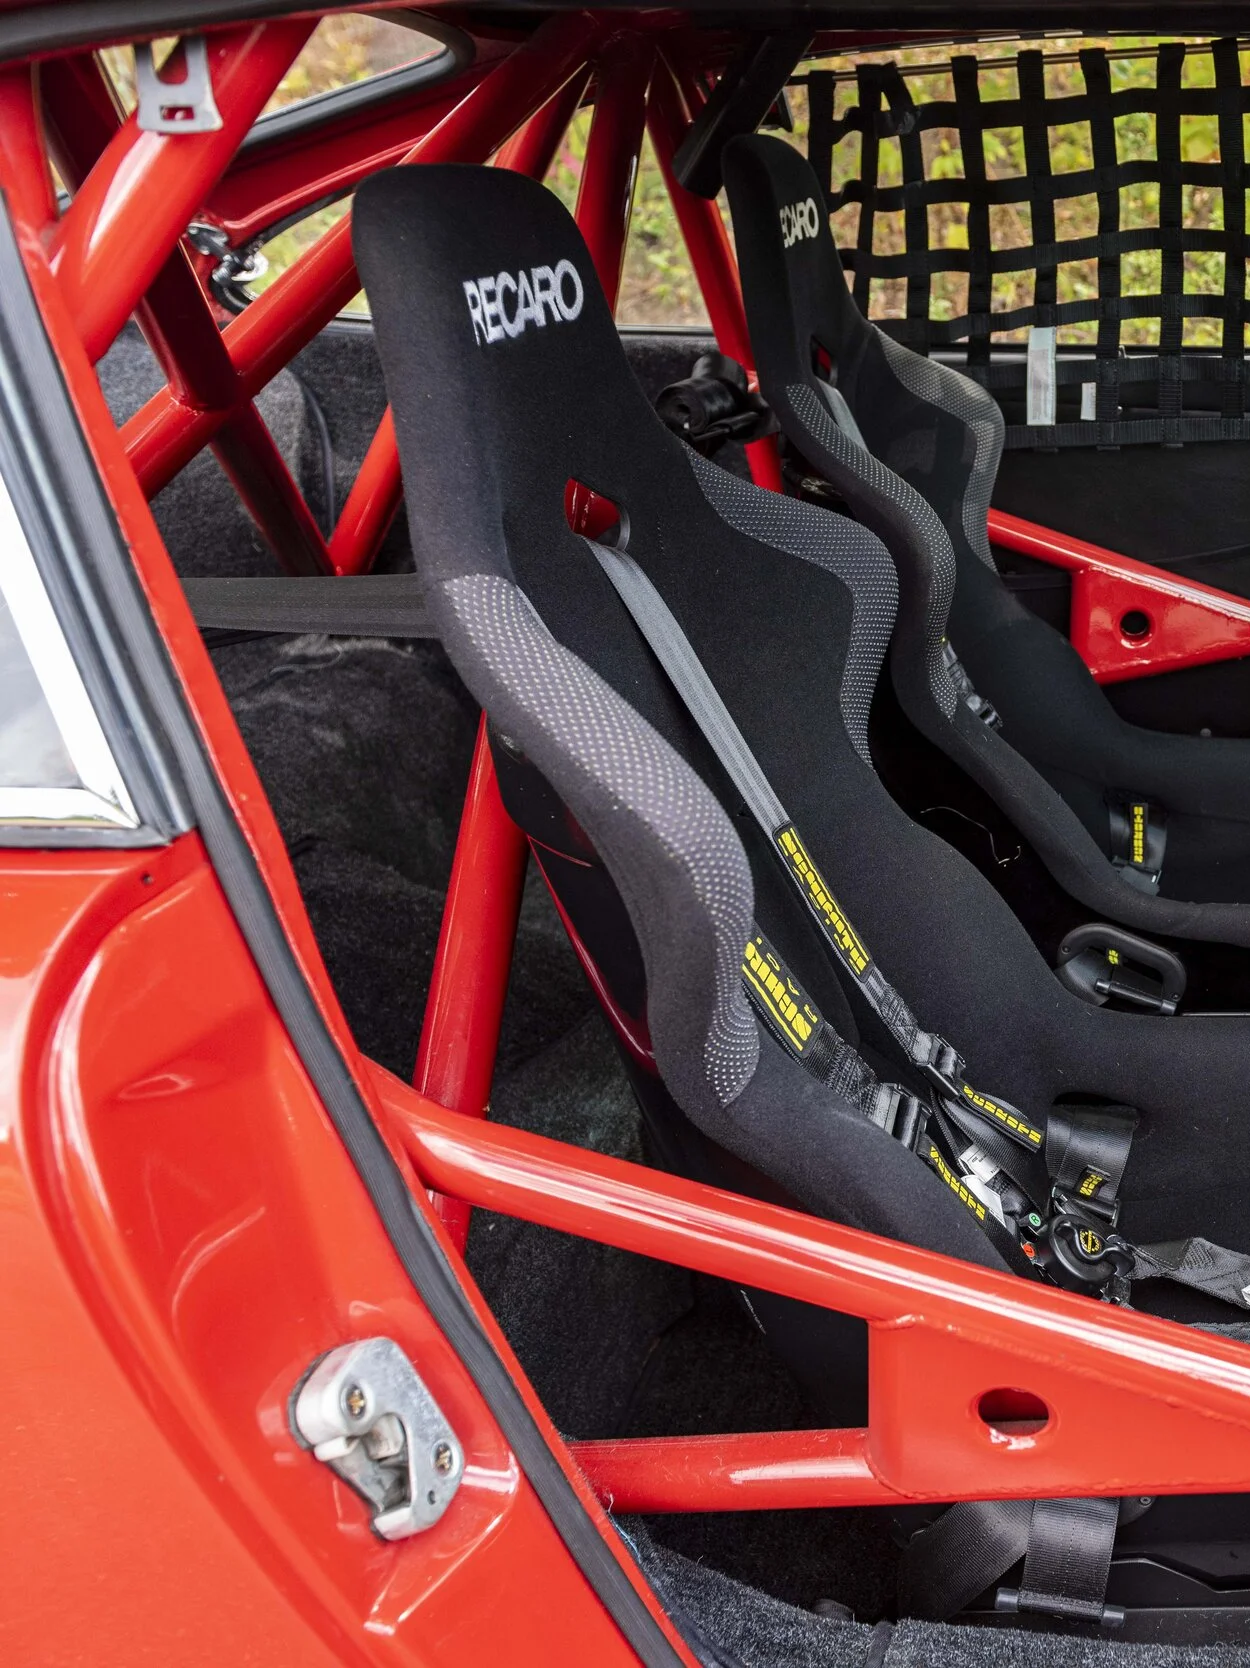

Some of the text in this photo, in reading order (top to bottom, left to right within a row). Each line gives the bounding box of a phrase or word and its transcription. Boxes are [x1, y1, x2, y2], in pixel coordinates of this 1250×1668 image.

[779, 197, 820, 249] ECARO
[462, 258, 584, 346] RECARO
[781, 831, 867, 971] SCHROTH
[744, 941, 812, 1041] SCHR
[756, 936, 818, 1023] RACI
[963, 1086, 1041, 1143] SCHROTH
